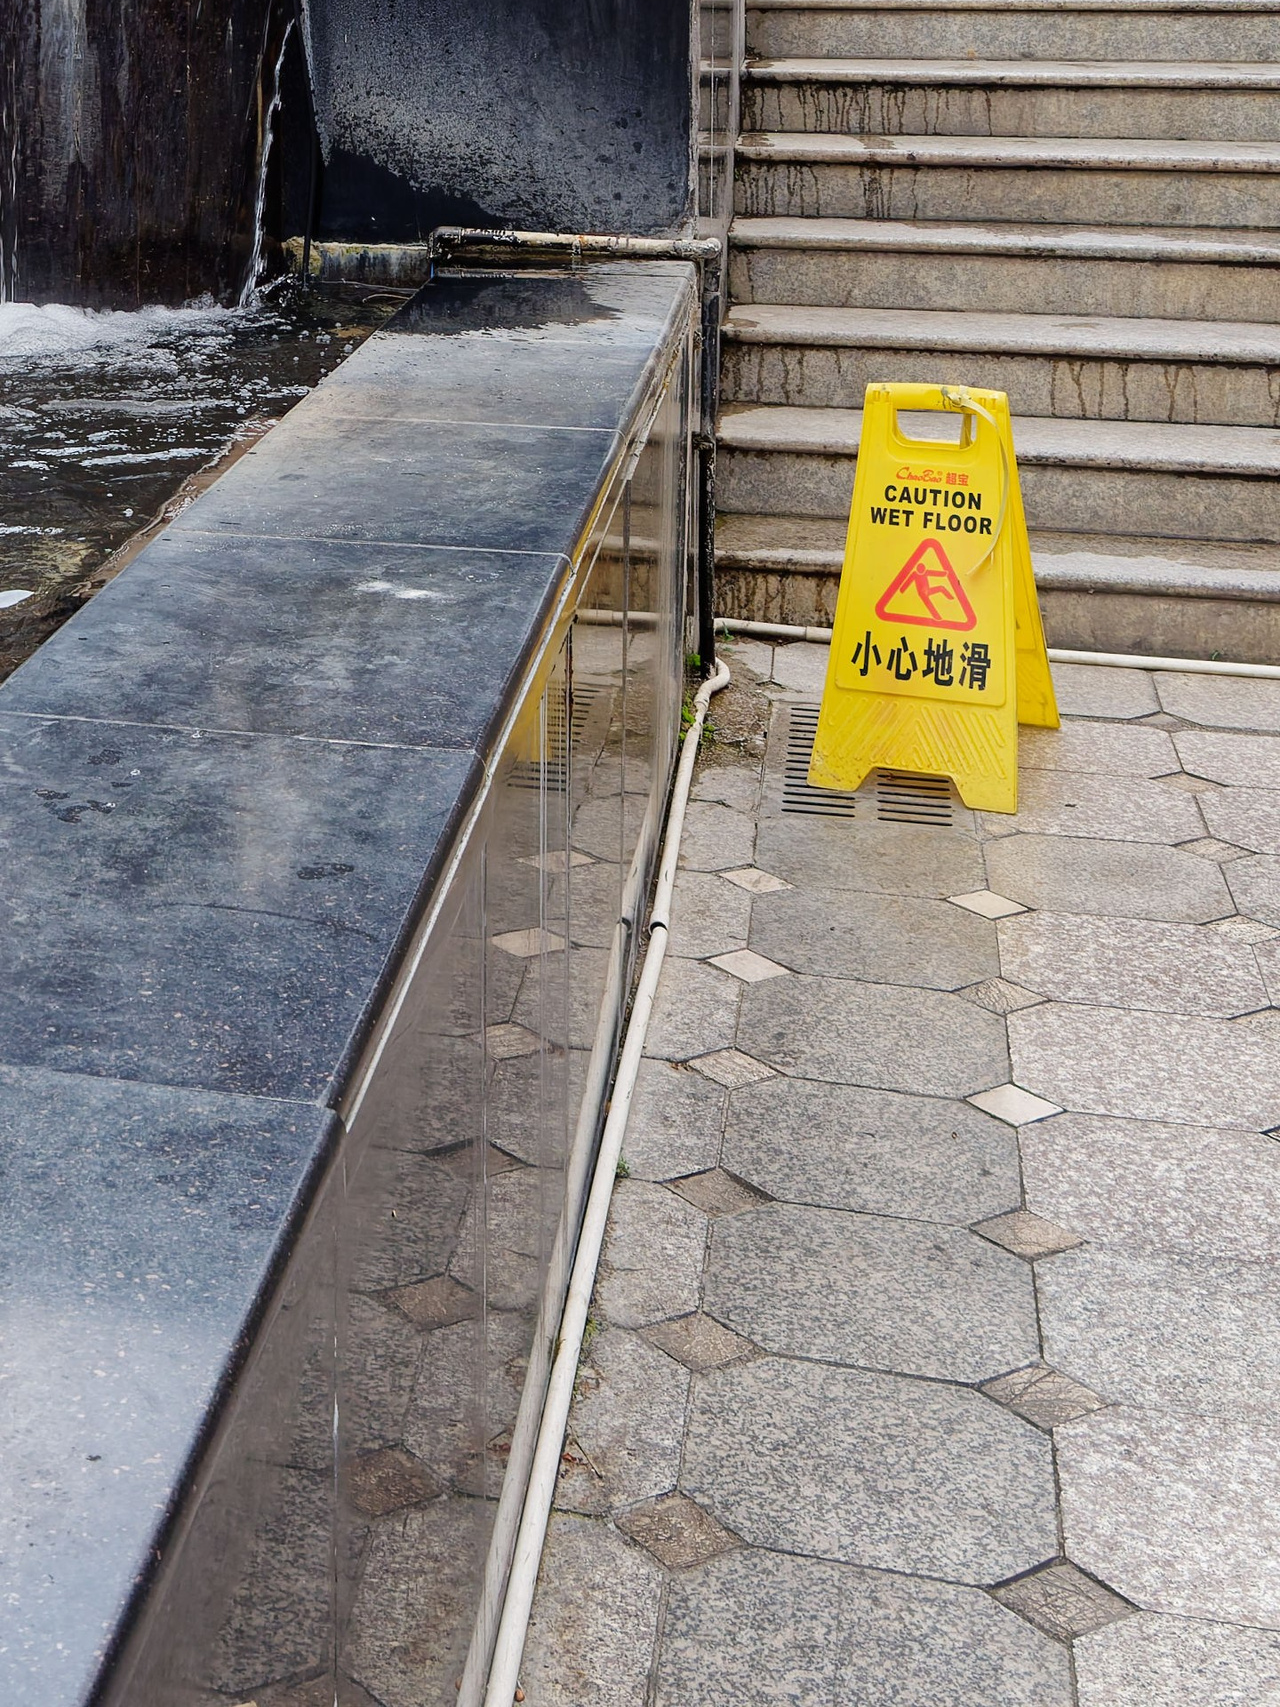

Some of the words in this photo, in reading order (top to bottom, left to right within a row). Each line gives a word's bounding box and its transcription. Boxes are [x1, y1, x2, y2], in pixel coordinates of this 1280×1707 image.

[945, 472, 970, 487] 超宝
[884, 484, 982, 511] CAUTION
[870, 506, 915, 527] WET
[923, 511, 992, 535] FLOOR
[851, 630, 991, 691] 小心地滑
